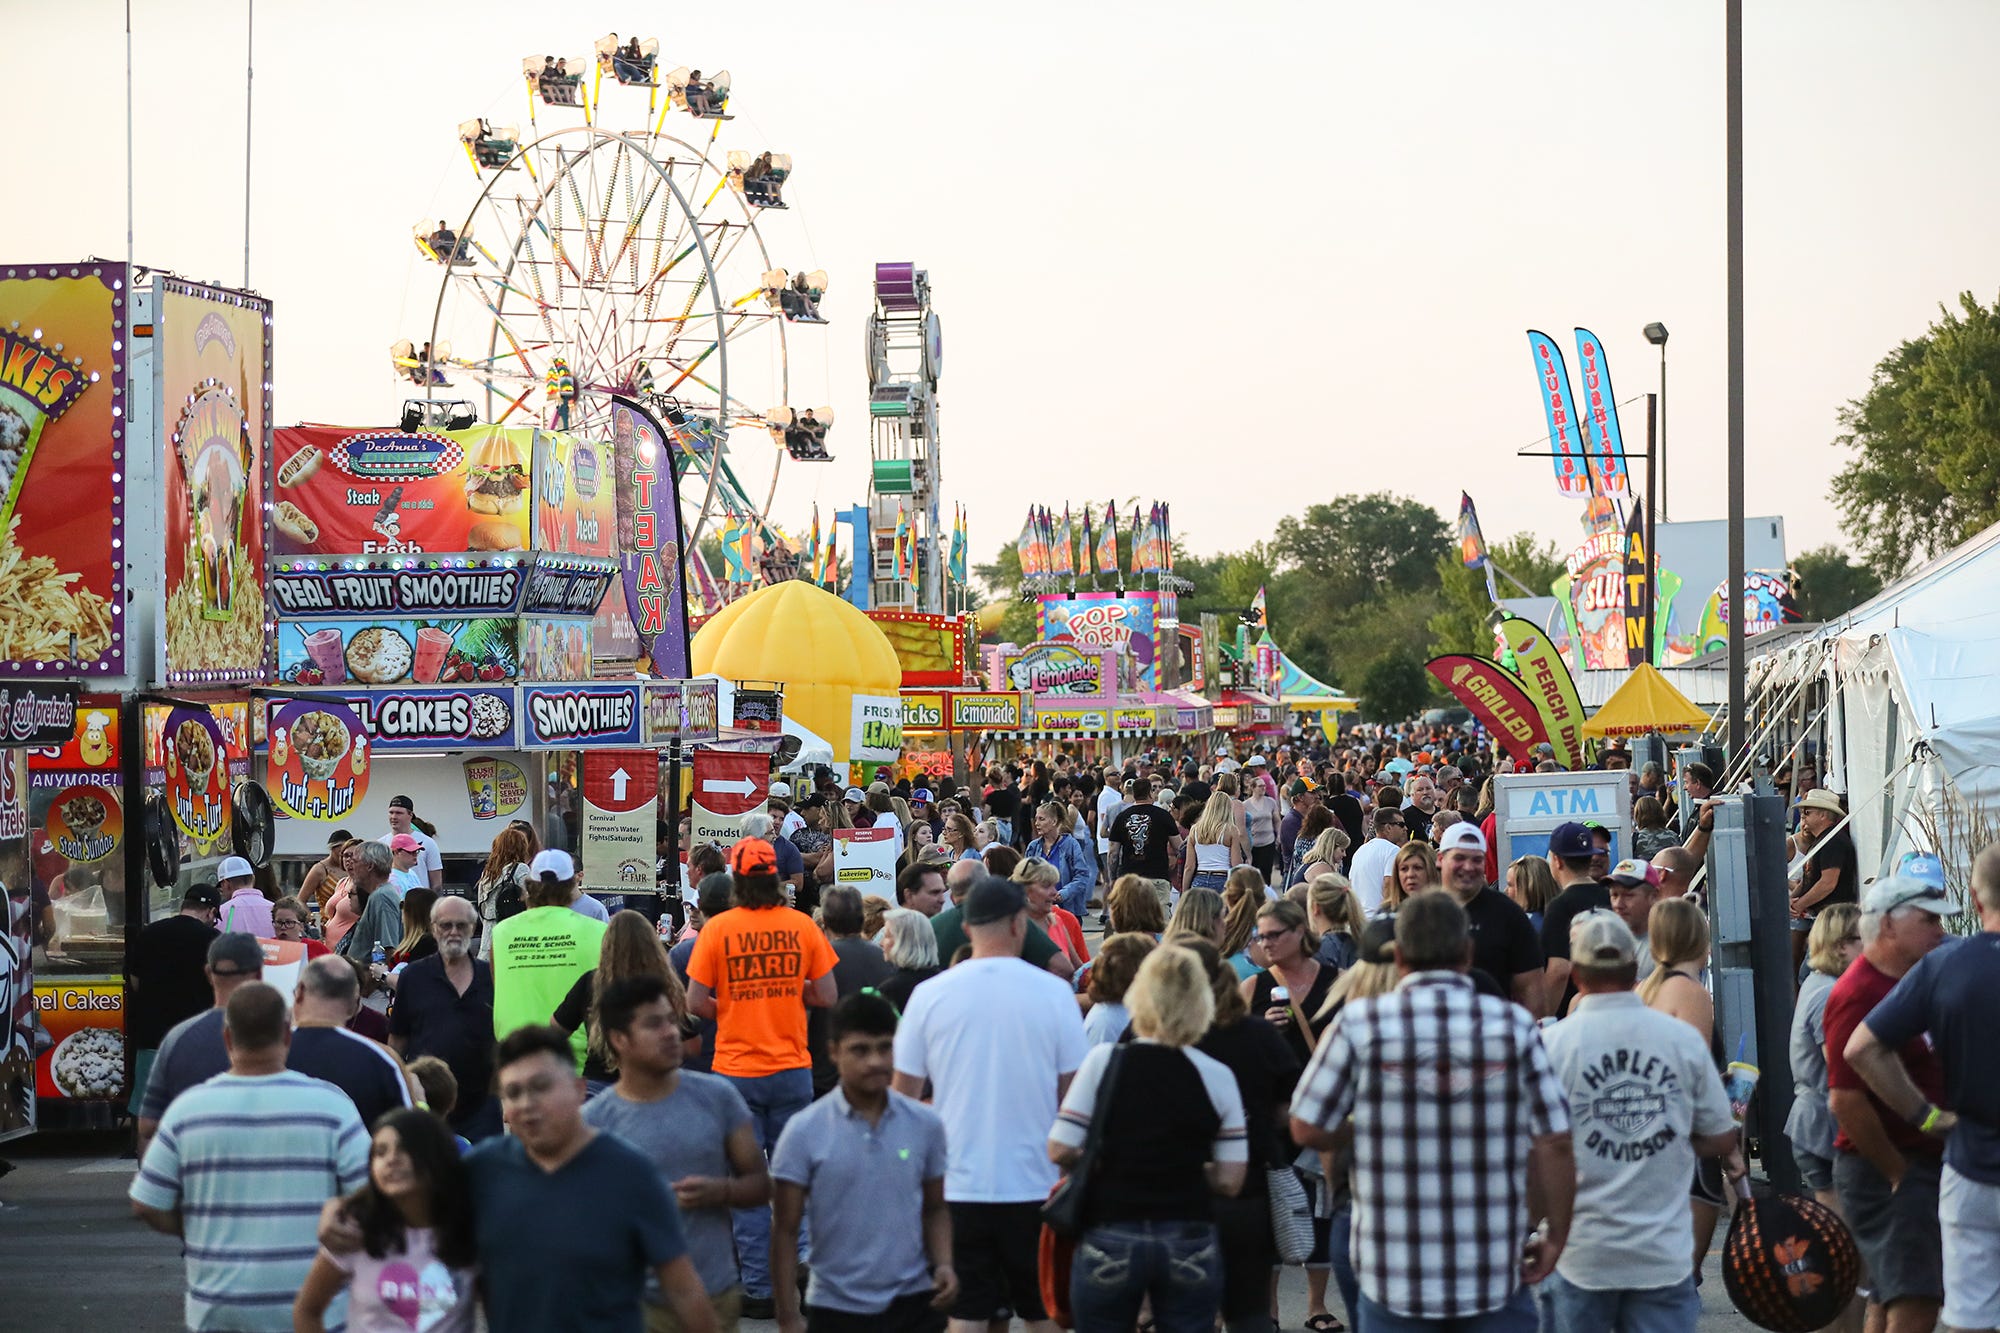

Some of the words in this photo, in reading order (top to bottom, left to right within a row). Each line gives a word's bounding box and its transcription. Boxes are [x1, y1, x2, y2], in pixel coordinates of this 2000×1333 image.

[365, 440, 427, 452] DeAnna's
[346, 487, 381, 505] Steak
[575, 507, 599, 543] Steak
[362, 540, 423, 554] Fresh
[275, 577, 332, 608] REAL
[332, 577, 393, 608] FRUIT
[400, 573, 517, 607] SMOOTHIES
[539, 576, 570, 605] FUNNEL
[567, 577, 600, 606] CAKES
[1066, 605, 1128, 635] POP
[1194, 637, 1202, 680] FRIES
[1030, 657, 1098, 693] Lemonade
[1530, 656, 1569, 722] PERCH
[14, 690, 35, 726] soft
[33, 692, 74, 736] pretzels
[381, 699, 469, 735] CAKES
[533, 694, 633, 737] SMOOTHIES
[955, 700, 1015, 724] Lemonade
[1041, 713, 1079, 729] Cakes
[1465, 674, 1534, 743] GRILLED
[1117, 715, 1152, 729] Water
[906, 752, 954, 764] CORN
[32, 773, 118, 788] ANYMORE!
[500, 789, 525, 797] SERVED
[280, 771, 356, 819] Surf-n-Turf
[500, 797, 520, 806] HERE!
[1528, 788, 1600, 816] ATM
[175, 785, 223, 837] Surf-n-Turf
[589, 814, 616, 822] Carnival
[589, 825, 620, 833] Fireman's
[589, 833, 643, 843] Fights(Saturday)
[59, 834, 84, 860] Steak
[83, 831, 114, 860] Sundae
[630, 873, 648, 882] FAIR
[839, 870, 869, 878] Lakeview
[508, 942, 541, 950] DRIVING
[724, 935, 730, 956] I
[737, 930, 801, 953] WORK
[728, 952, 801, 982] HARD
[63, 990, 121, 1010] Cakes
[767, 987, 782, 998] ON
[1585, 1122, 1677, 1163] DAVIDSON
